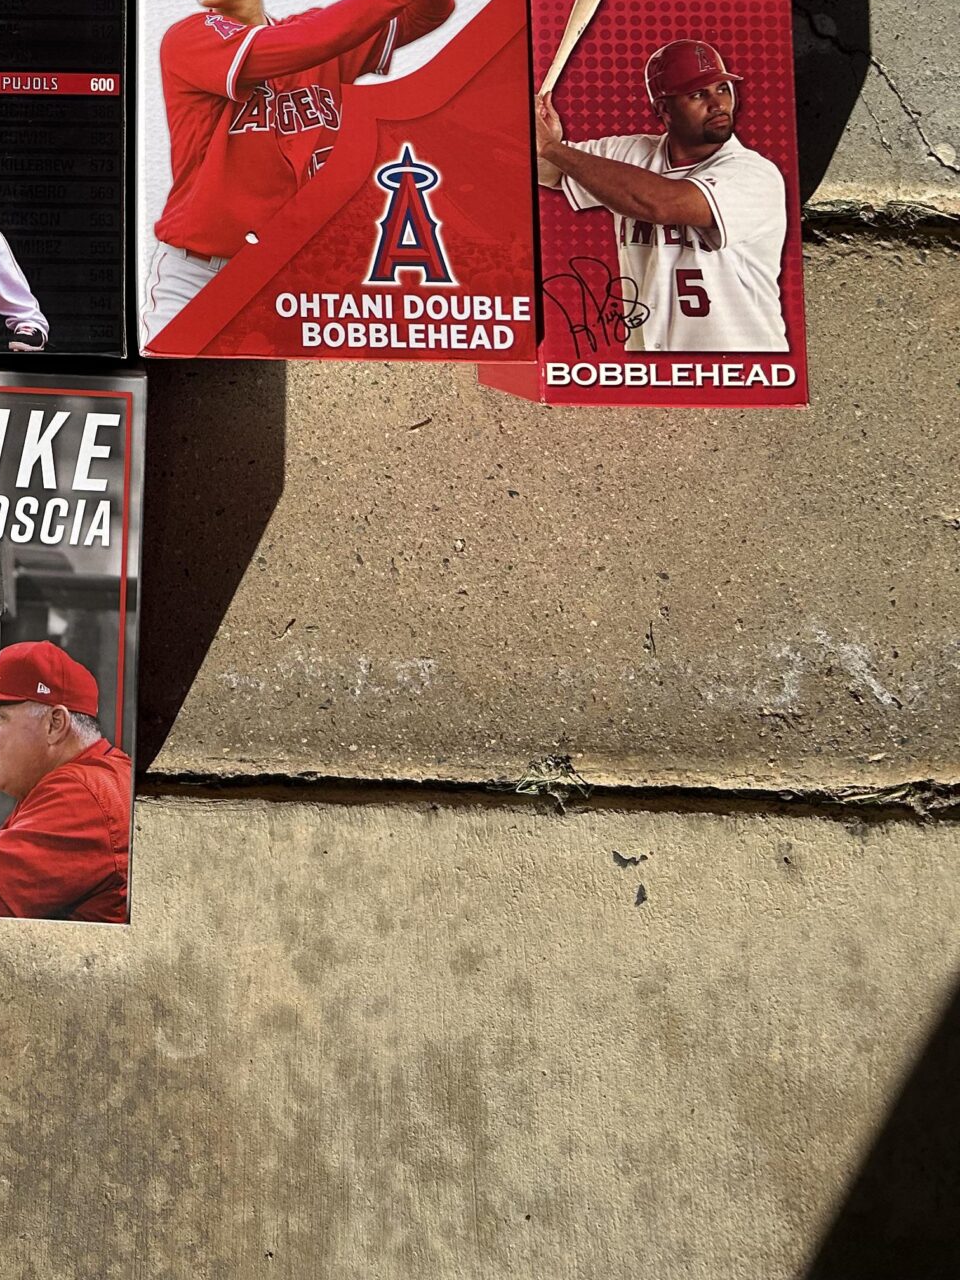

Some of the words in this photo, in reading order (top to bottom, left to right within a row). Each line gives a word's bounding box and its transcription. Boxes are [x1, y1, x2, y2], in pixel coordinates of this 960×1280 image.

[2, 76, 59, 92] PUJOLS
[90, 77, 115, 93] 600
[275, 293, 394, 319] OHTANI
[403, 294, 531, 322] DOUBLE
[675, 269, 712, 318] 5
[301, 322, 515, 351] BOBBLEHEAD
[546, 362, 797, 388] BOBBLEHEAD
